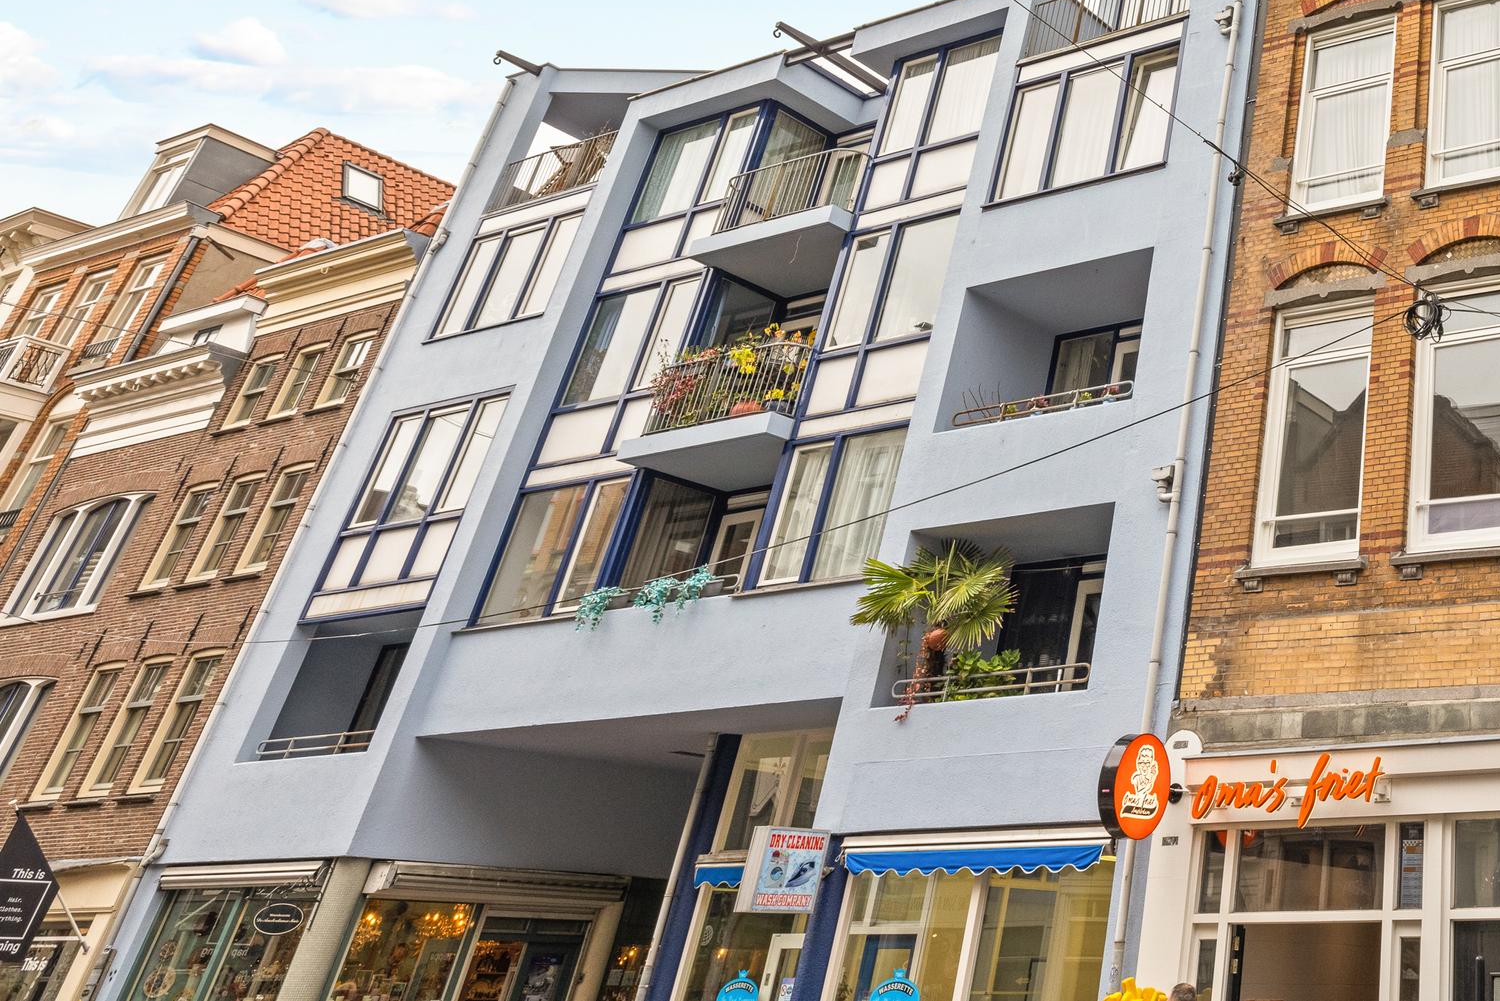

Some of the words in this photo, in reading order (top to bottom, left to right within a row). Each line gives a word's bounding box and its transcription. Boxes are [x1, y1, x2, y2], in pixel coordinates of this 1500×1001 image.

[1191, 759, 1289, 820] Oma's
[1296, 752, 1386, 830] friet
[769, 833, 788, 849] DRY
[786, 835, 825, 851] CLEANING
[12, 868, 34, 879] This
[35, 868, 46, 880] is
[756, 894, 778, 906] WASH
[777, 894, 812, 907] COMPANY
[725, 982, 754, 993] WASSERETTE
[878, 982, 914, 996] WASSERETTE
